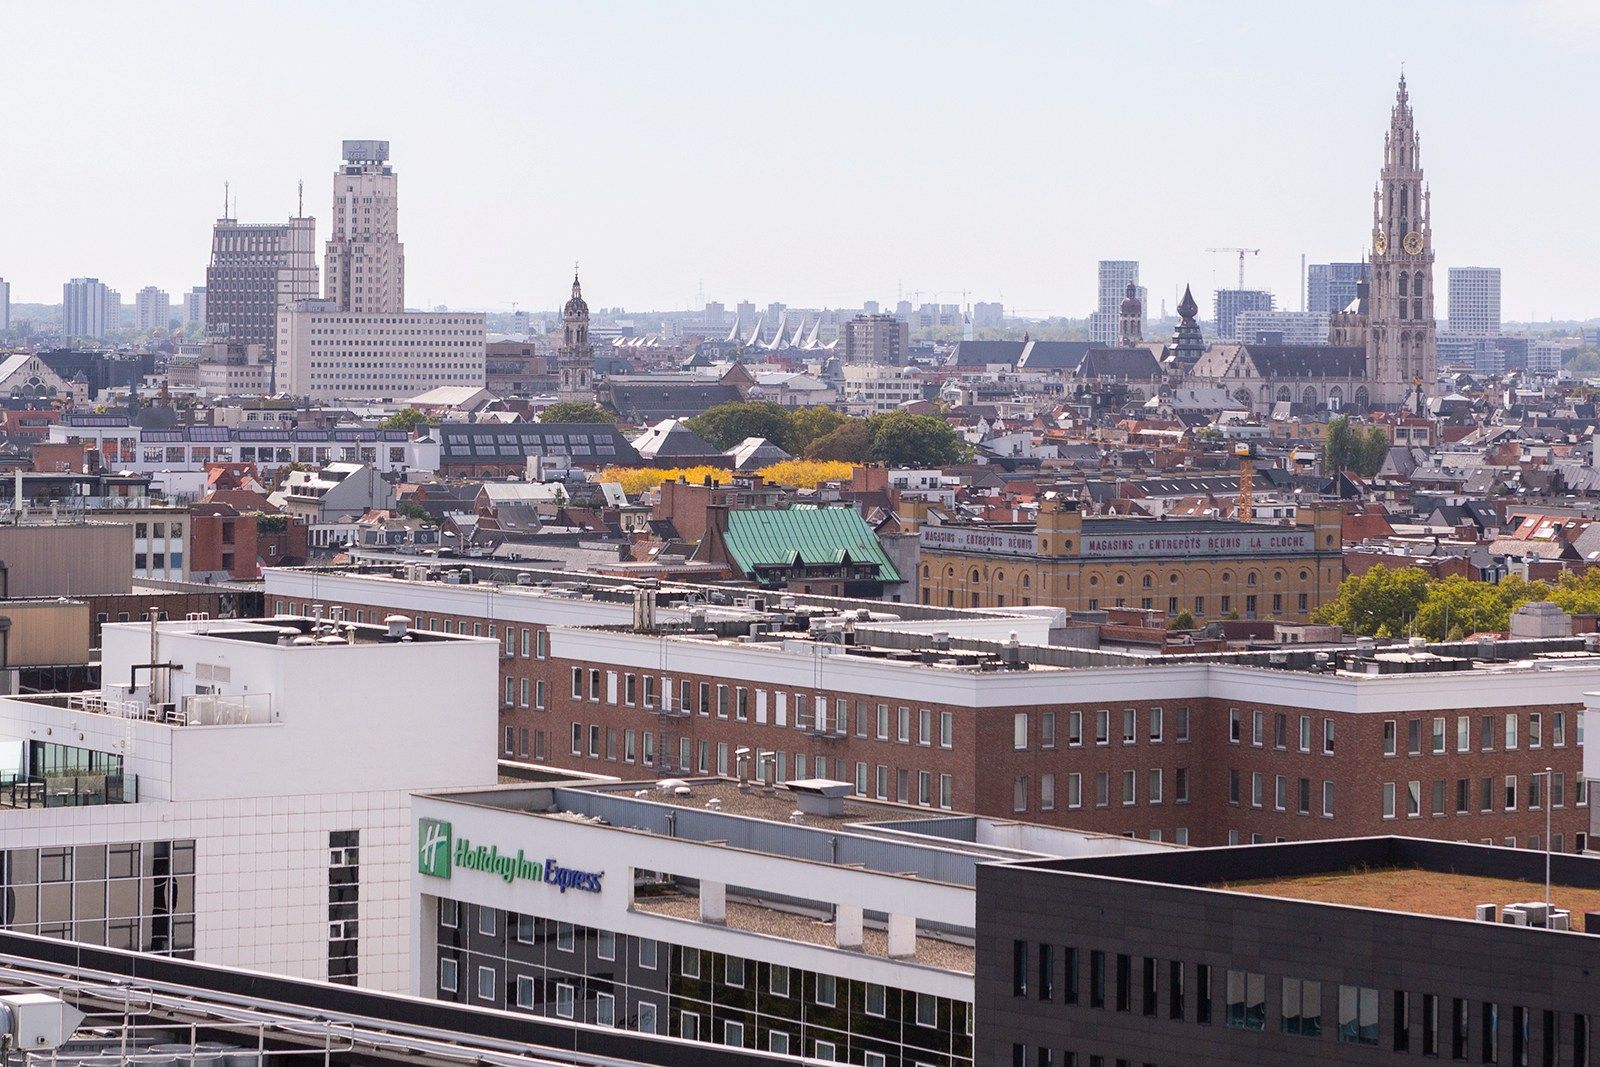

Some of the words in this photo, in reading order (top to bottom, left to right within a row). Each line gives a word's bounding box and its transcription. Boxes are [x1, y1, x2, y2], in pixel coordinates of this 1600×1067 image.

[925, 531, 955, 543] MAGASINS
[1089, 540, 1134, 551] MAGASINS
[1250, 538, 1262, 548] LA
[1270, 536, 1305, 547] CLOCHE
[543, 858, 603, 894] Express
